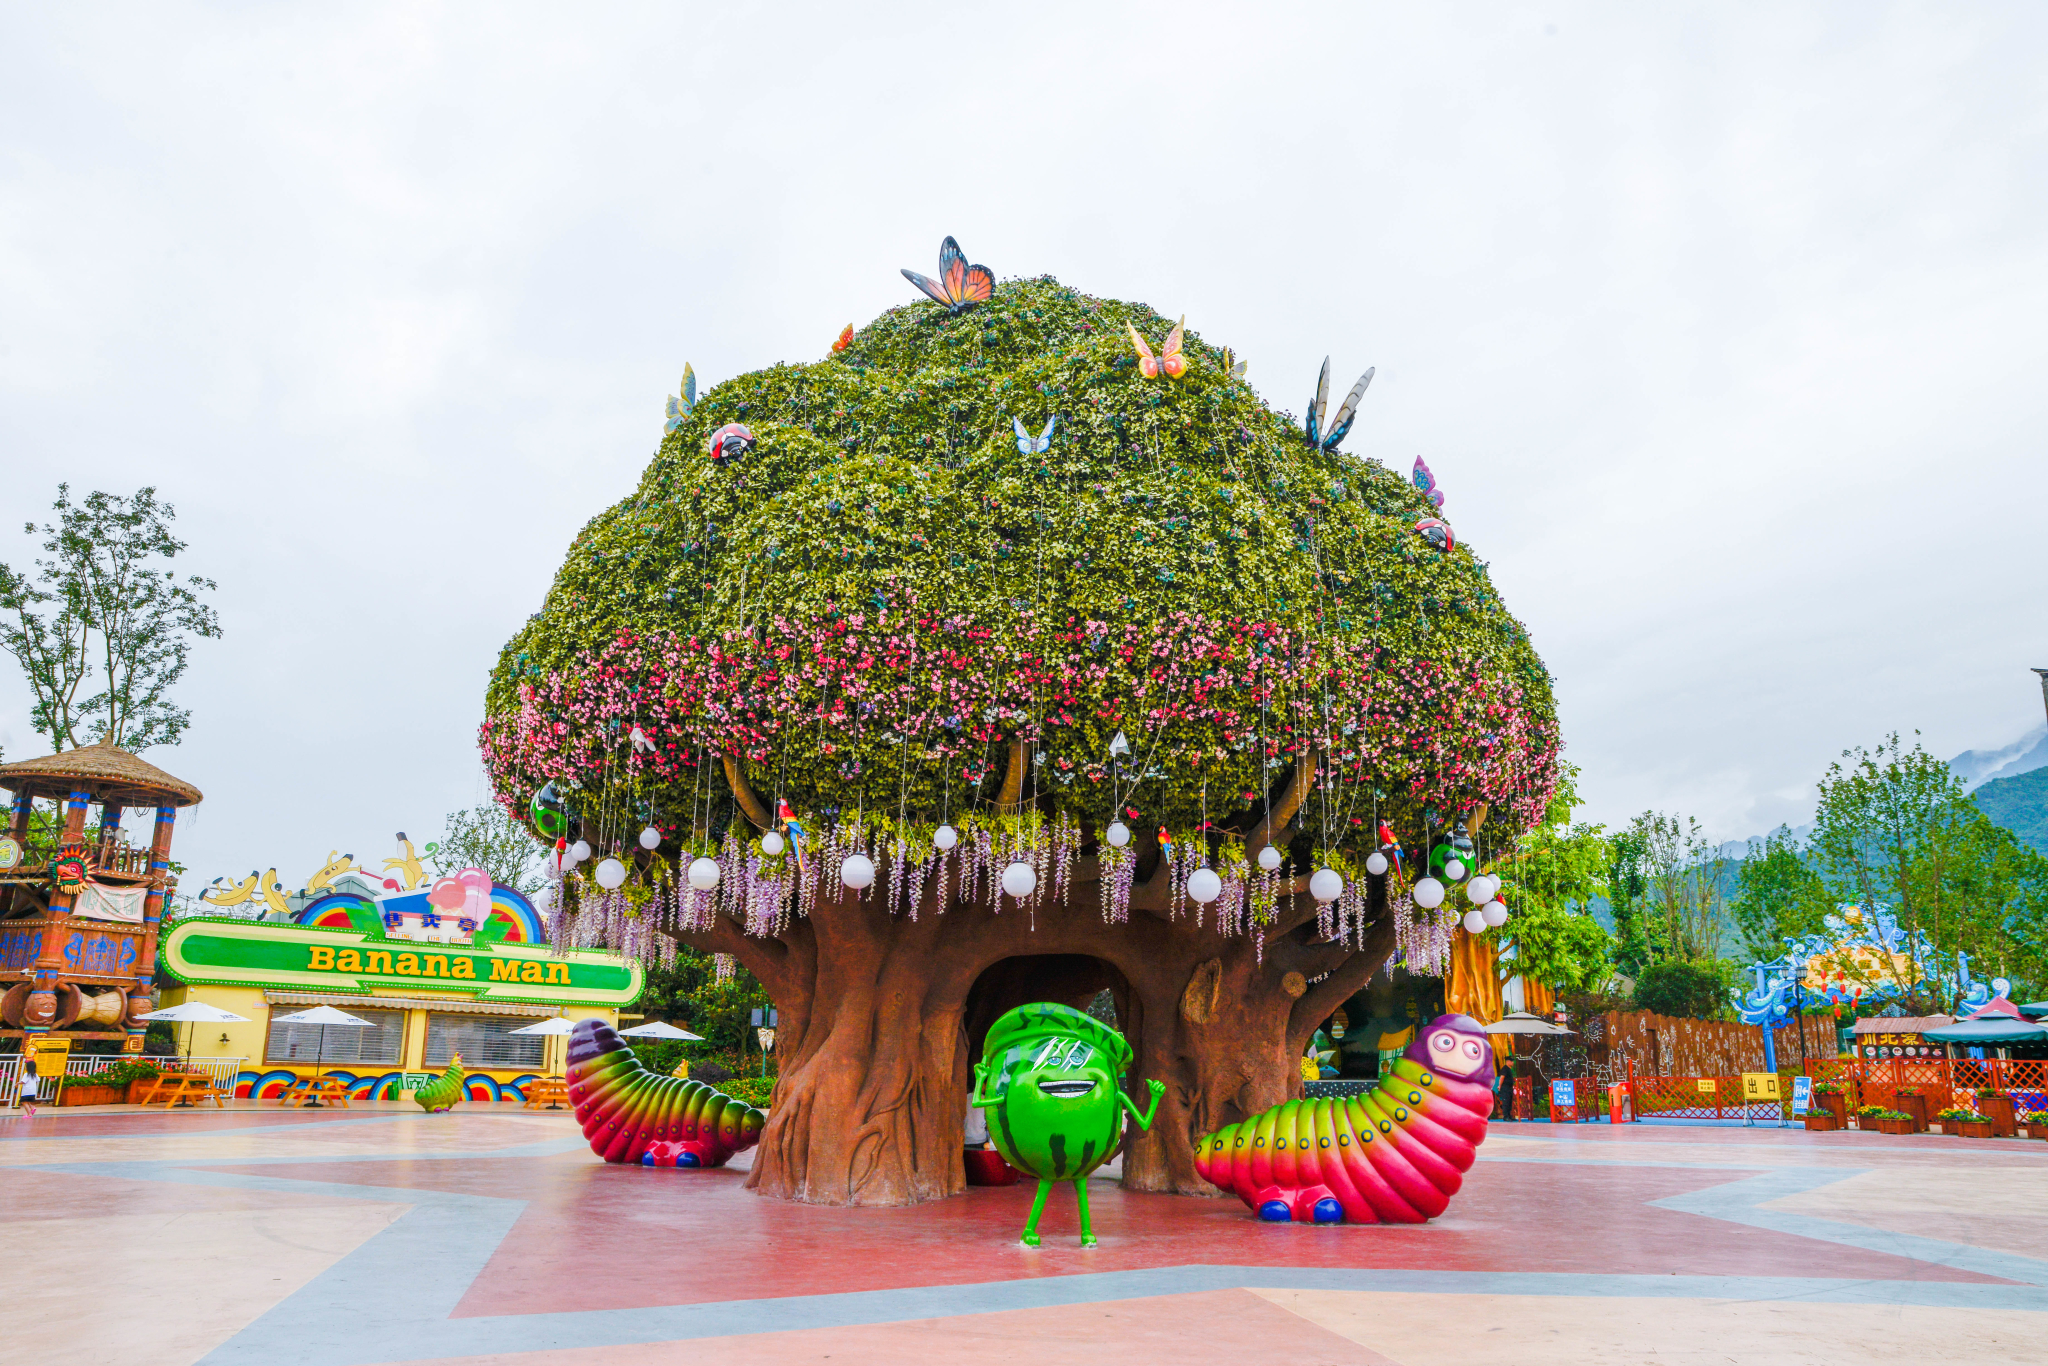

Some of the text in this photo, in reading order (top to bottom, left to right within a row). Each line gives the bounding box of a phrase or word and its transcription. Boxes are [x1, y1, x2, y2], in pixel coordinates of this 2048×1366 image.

[307, 946, 571, 985] Banana Man
[1861, 1033, 1941, 1046] 川北凉
[1748, 1078, 1777, 1094] 出口
